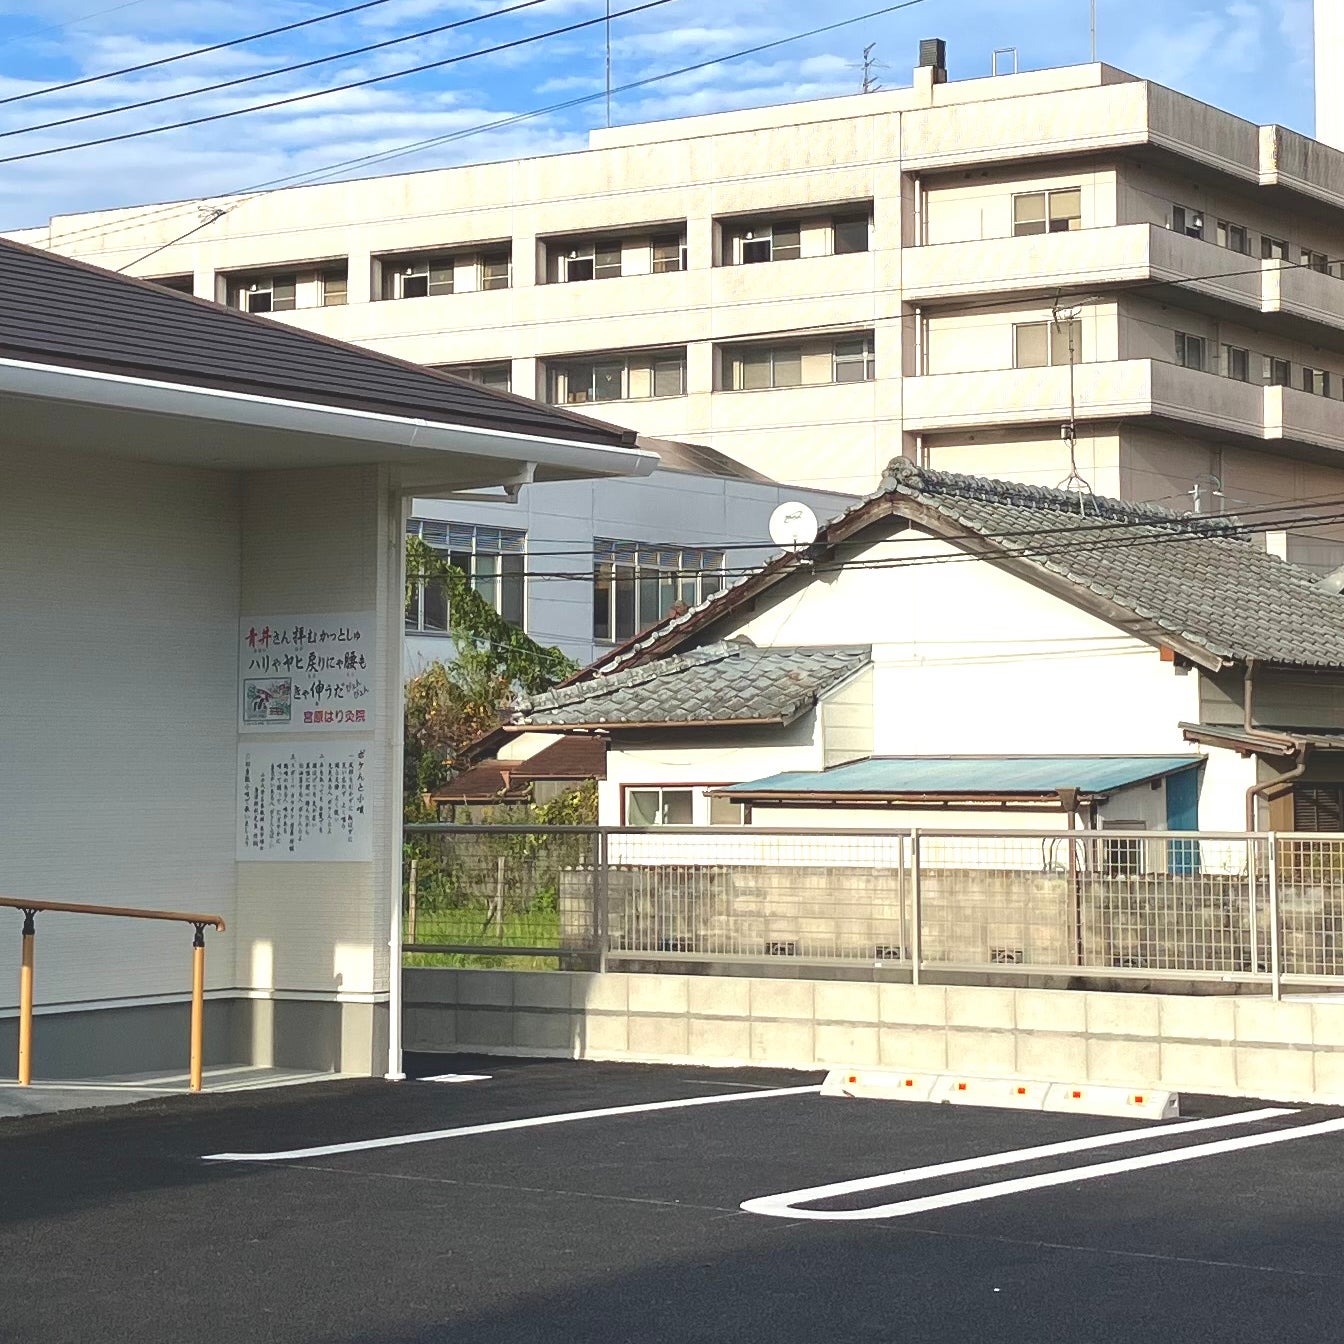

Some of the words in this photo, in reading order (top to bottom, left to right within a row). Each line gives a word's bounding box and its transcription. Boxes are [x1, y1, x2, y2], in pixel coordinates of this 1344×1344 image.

[303, 709, 366, 724] 宮原はり灸院
